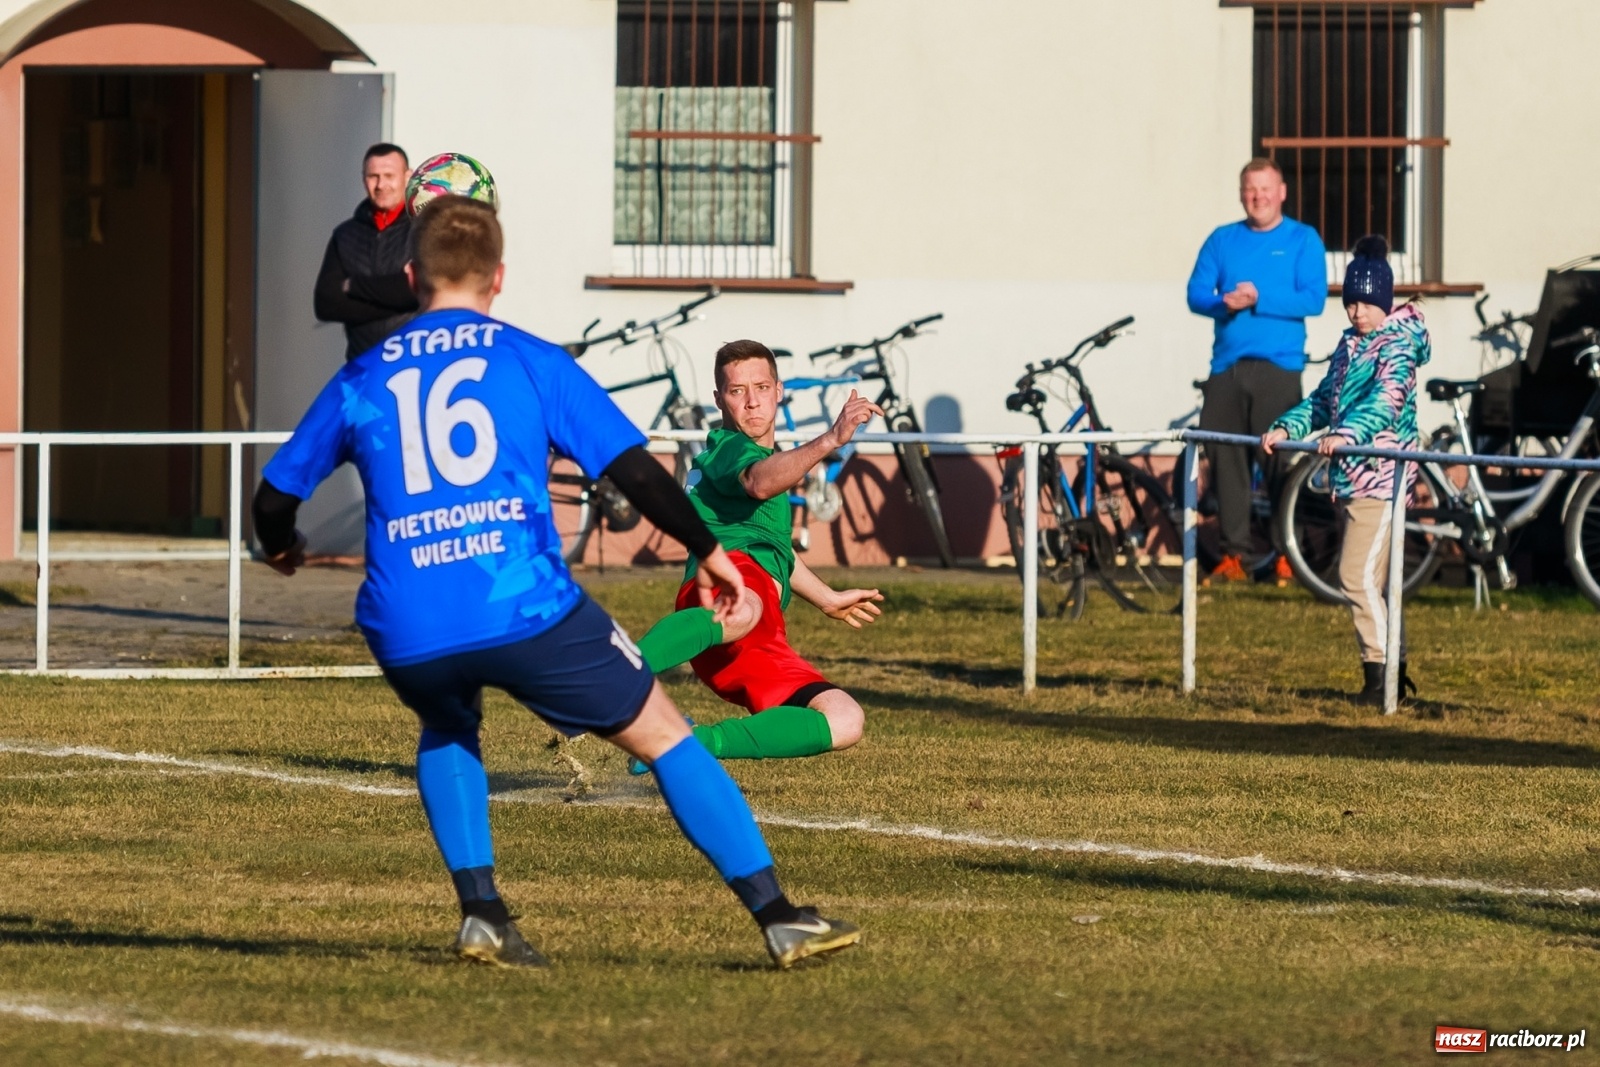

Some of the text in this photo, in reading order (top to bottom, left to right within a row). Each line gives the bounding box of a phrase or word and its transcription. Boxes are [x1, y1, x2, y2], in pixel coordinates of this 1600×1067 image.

[382, 323, 503, 362] START
[385, 356, 498, 496] 16
[387, 497, 526, 543] PIETROWICE
[411, 530, 506, 569] WIELKIE
